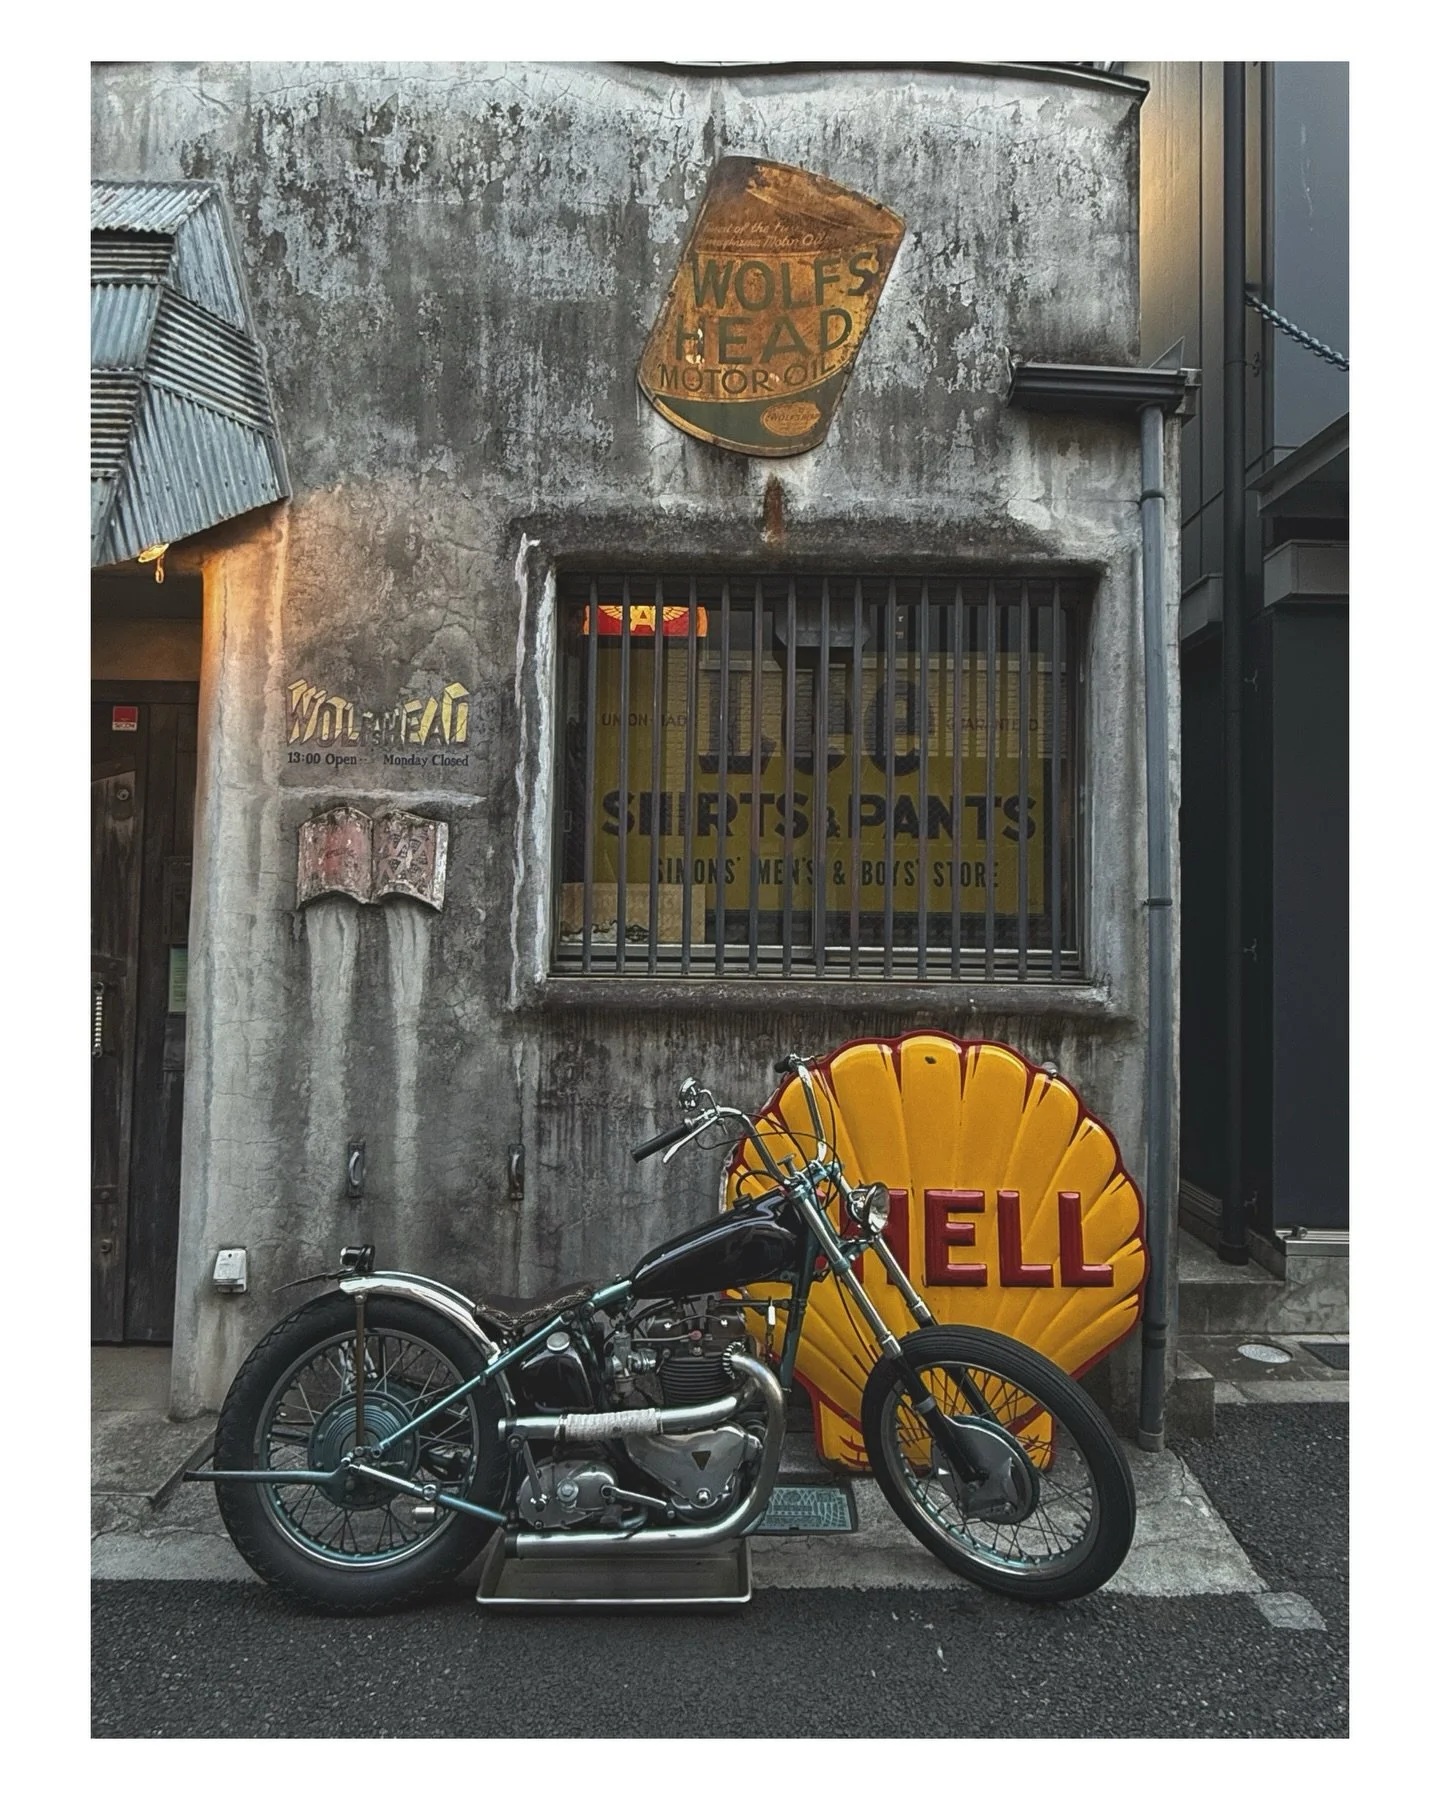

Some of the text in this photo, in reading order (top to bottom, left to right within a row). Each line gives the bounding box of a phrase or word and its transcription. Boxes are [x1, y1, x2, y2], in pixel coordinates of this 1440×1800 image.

[751, 221, 769, 233] the
[675, 308, 853, 365] HEAD
[660, 361, 837, 394] MOTOR OIL
[288, 752, 469, 768] 13:00 Open Monday Closed
[848, 793, 1036, 842] PANTS
[833, 860, 846, 886] &
[814, 1188, 1115, 1289] HELL
